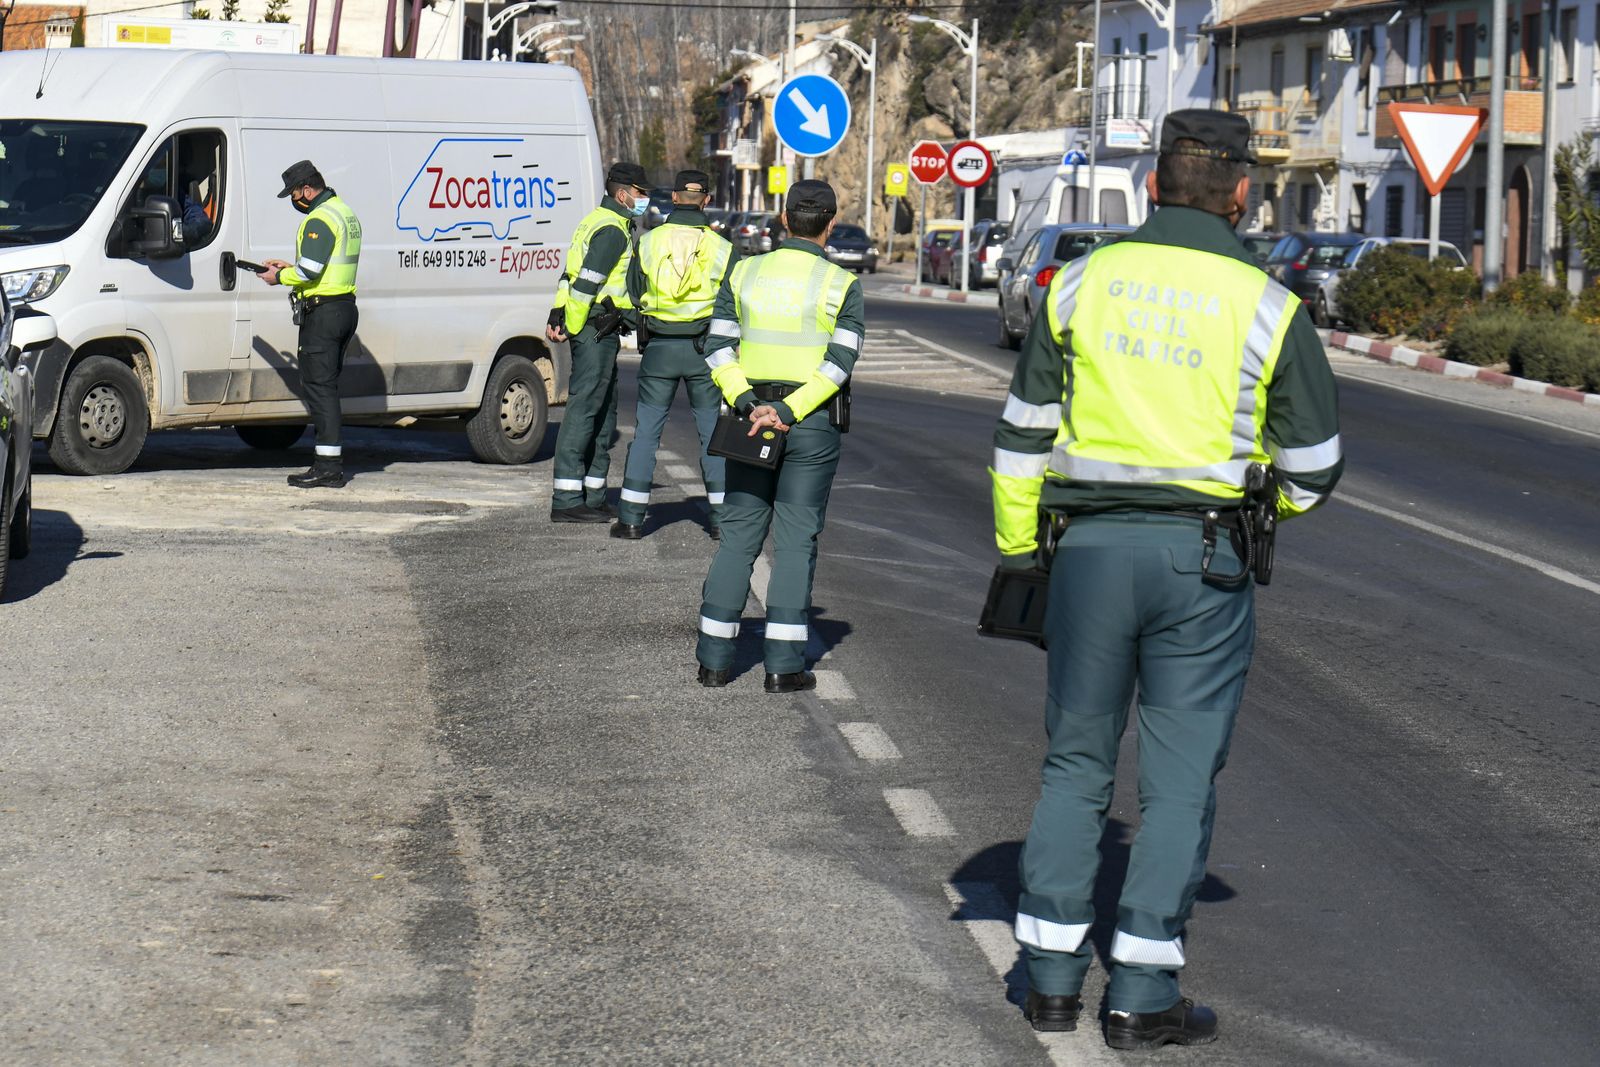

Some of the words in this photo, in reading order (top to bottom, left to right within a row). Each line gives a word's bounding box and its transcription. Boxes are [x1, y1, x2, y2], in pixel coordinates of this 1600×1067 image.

[912, 156, 946, 168] STOP
[427, 167, 556, 209] Zocatrans
[398, 250, 420, 268] Telf.
[423, 250, 443, 268] 649
[445, 250, 465, 268] 915
[467, 250, 487, 267] 248
[499, 246, 561, 278] Express
[1108, 279, 1220, 317] GUARDIA
[1127, 308, 1187, 338] CIVIL
[1104, 331, 1203, 369] TRAFICO
